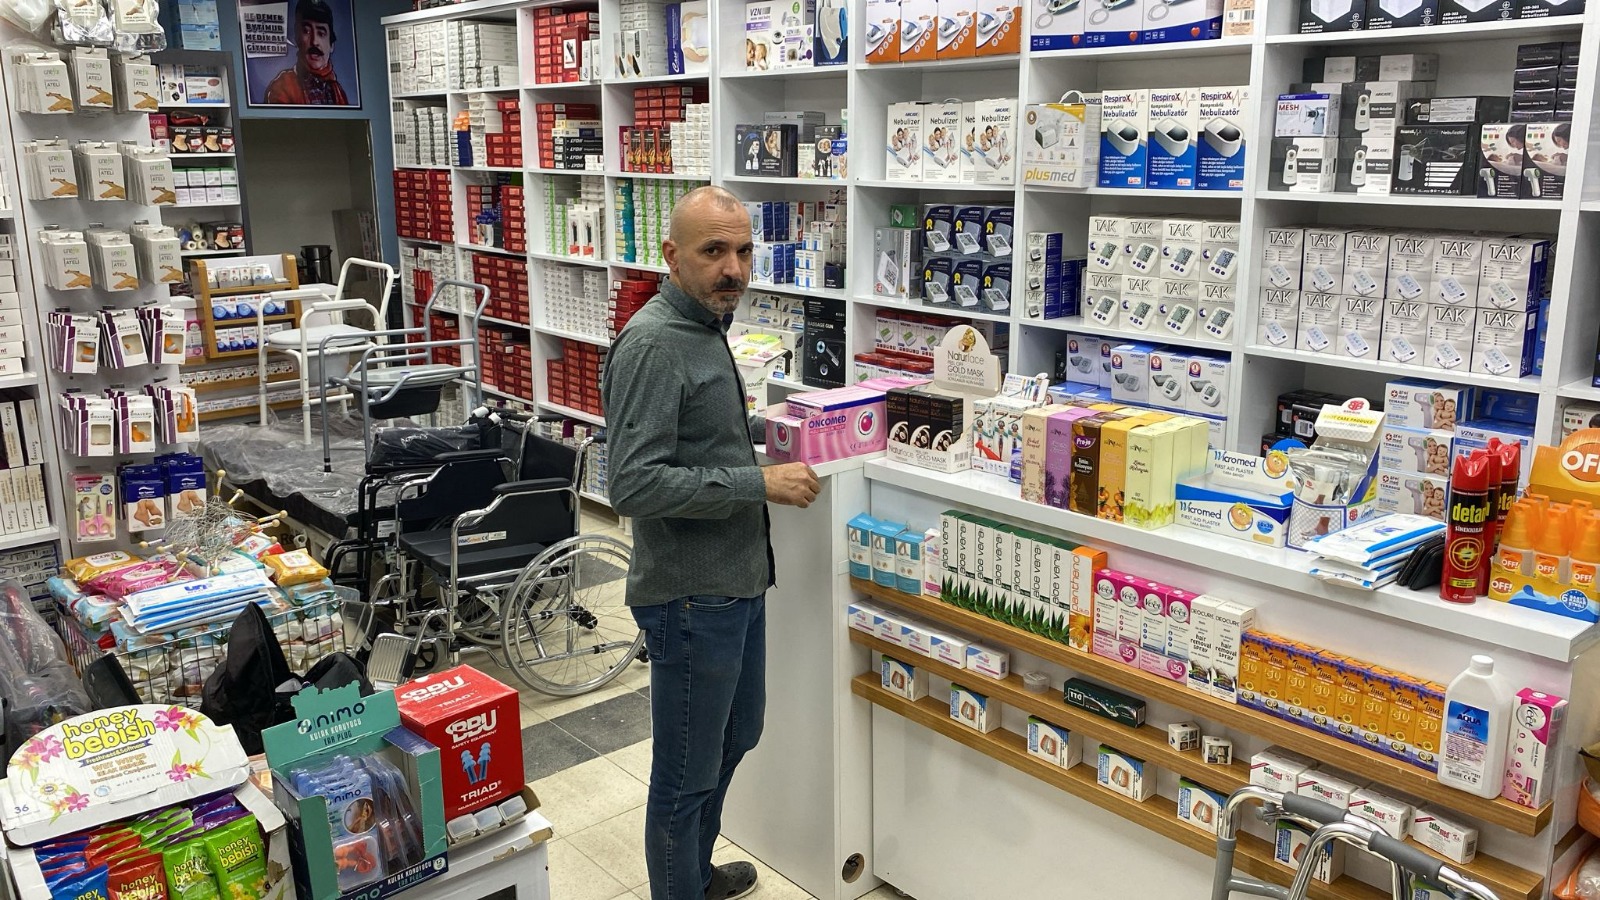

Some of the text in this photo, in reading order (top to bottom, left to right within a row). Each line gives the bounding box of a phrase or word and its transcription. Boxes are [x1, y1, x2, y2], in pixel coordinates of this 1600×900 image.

[750, 8, 761, 16] VZN
[1104, 94, 1131, 103] RespiroX
[1151, 93, 1180, 102] RespiroX
[1201, 91, 1232, 101] RespiroX
[1150, 109, 1188, 117] Nebulizatör
[1200, 108, 1240, 116] Nebulizatör
[1025, 168, 1076, 182] plusmed
[1095, 219, 1118, 233] TAK
[1130, 221, 1153, 235] TAK
[1169, 223, 1194, 238] TAK
[1209, 225, 1234, 239] TAK
[1269, 231, 1297, 245] TAK
[1310, 234, 1337, 248] TAK
[1352, 236, 1381, 250] TAK
[1395, 238, 1425, 254] TAK
[1441, 241, 1473, 257] TAK
[1489, 244, 1523, 261] TAK
[1092, 274, 1114, 288] TAK
[1128, 277, 1152, 292] TAK
[1165, 282, 1189, 296] TAK
[1205, 284, 1230, 299] TAK
[1266, 289, 1293, 304] TAK
[1305, 293, 1332, 308] TAK
[1346, 298, 1374, 313] TAK
[1390, 300, 1420, 317] TAK
[1435, 306, 1467, 323] TAK
[1483, 310, 1518, 328] TAK
[947, 365, 984, 378] GOLD MASK
[809, 415, 847, 429] ONCOMED
[916, 454, 946, 464] GOLD MASK
[1214, 451, 1257, 468] Micromed
[1180, 501, 1222, 519] Micromed
[1203, 518, 1221, 527] PLASTER
[1502, 560, 1520, 569] OFF!
[1537, 564, 1555, 573] OFF!
[1032, 546, 1041, 598] aloe vera
[1573, 574, 1592, 584] OFF!
[1052, 582, 1060, 604] aloe
[1098, 584, 1113, 595] Veet
[1491, 581, 1513, 592] OFF!
[1121, 591, 1137, 600] Veet
[1562, 594, 1568, 602] 6
[1145, 598, 1161, 608] Veet
[1171, 606, 1187, 616] Veet
[1190, 638, 1211, 649] removal
[1194, 645, 1208, 653] spray
[1215, 646, 1237, 657] removal
[1219, 653, 1234, 661] spray
[316, 702, 365, 727] nimo
[1457, 714, 1481, 726] AQUA
[1526, 706, 1538, 728] Veet
[62, 709, 138, 738] honey
[310, 718, 362, 741] KULAK KORUYUCU
[445, 709, 497, 743] BBU
[63, 717, 156, 760] bebish
[324, 730, 352, 746] EAR PLUG
[452, 740, 470, 750] SAFETY
[115, 753, 147, 766] WIPES
[1264, 766, 1283, 781] sebamed
[334, 789, 361, 803] nimo
[461, 782, 499, 802] TRIAD
[1312, 784, 1333, 799] sebamed
[480, 796, 489, 804] EAR
[14, 805, 30, 814] 36
[1363, 804, 1386, 820] sebamed
[1429, 821, 1450, 840] sebamed
[219, 836, 249, 855] honey
[220, 842, 258, 868] bebish
[121, 874, 156, 892] honey
[388, 873, 405, 885] KULAK
